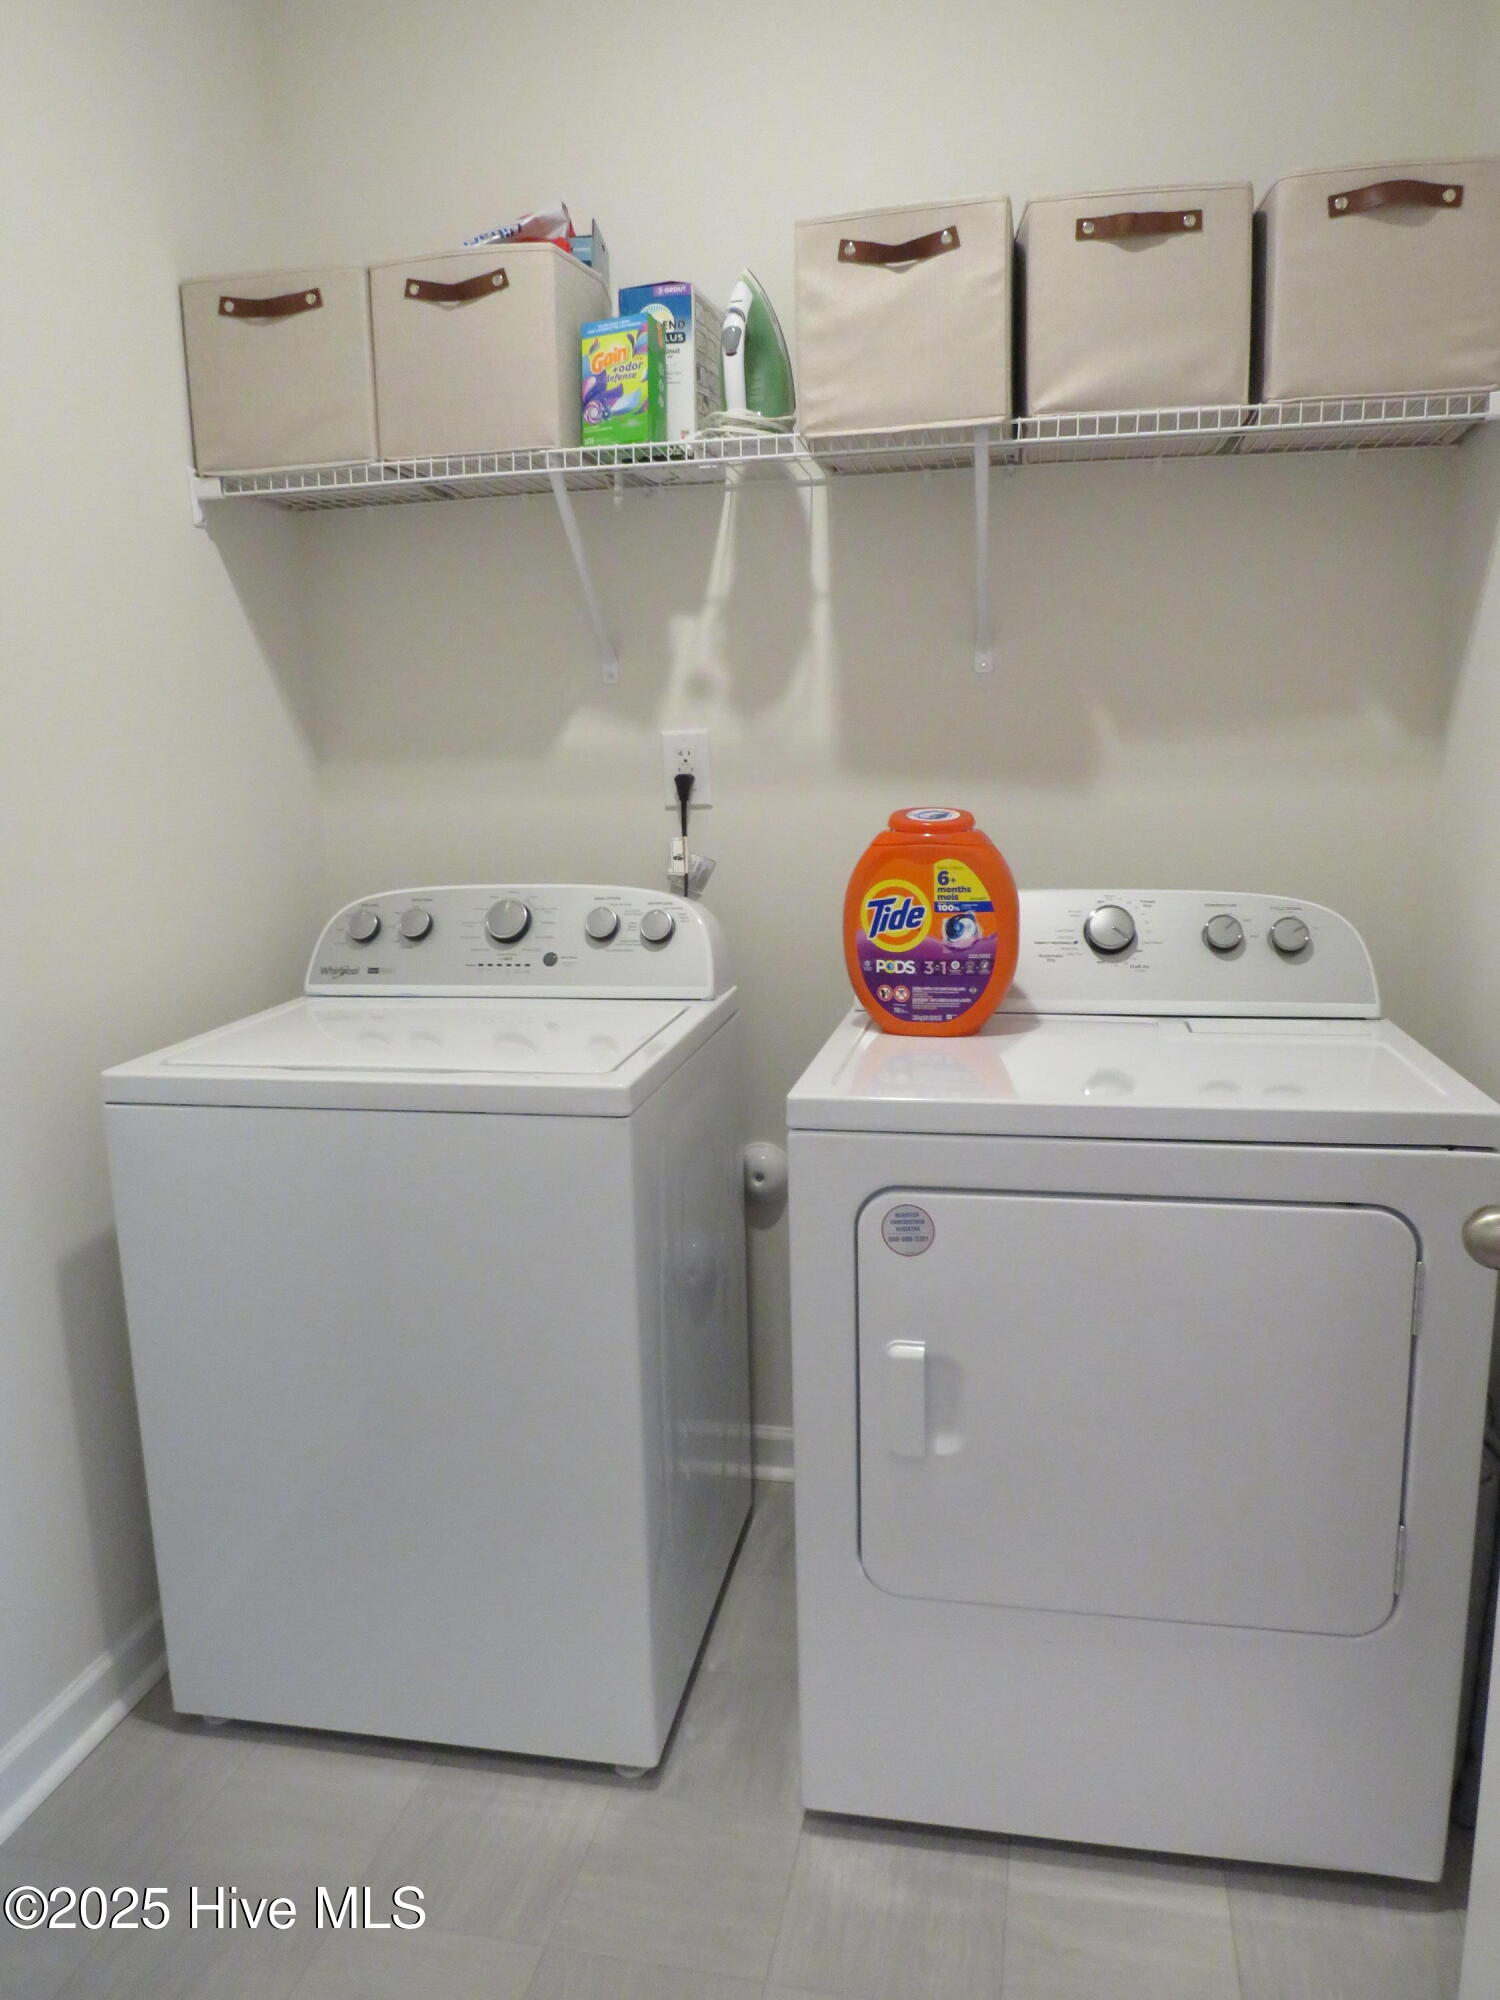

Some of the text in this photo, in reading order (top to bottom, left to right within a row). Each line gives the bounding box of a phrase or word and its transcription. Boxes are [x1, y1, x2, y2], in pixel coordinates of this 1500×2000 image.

[664, 285, 687, 294] GROUT
[590, 346, 629, 374] Gain
[607, 372, 637, 383] defense
[936, 886, 972, 894] months
[936, 893, 960, 901] mois
[937, 904, 961, 912] 100%
[867, 896, 926, 940] Tide
[319, 964, 360, 979] Whirlpool
[875, 959, 917, 975] PODS
